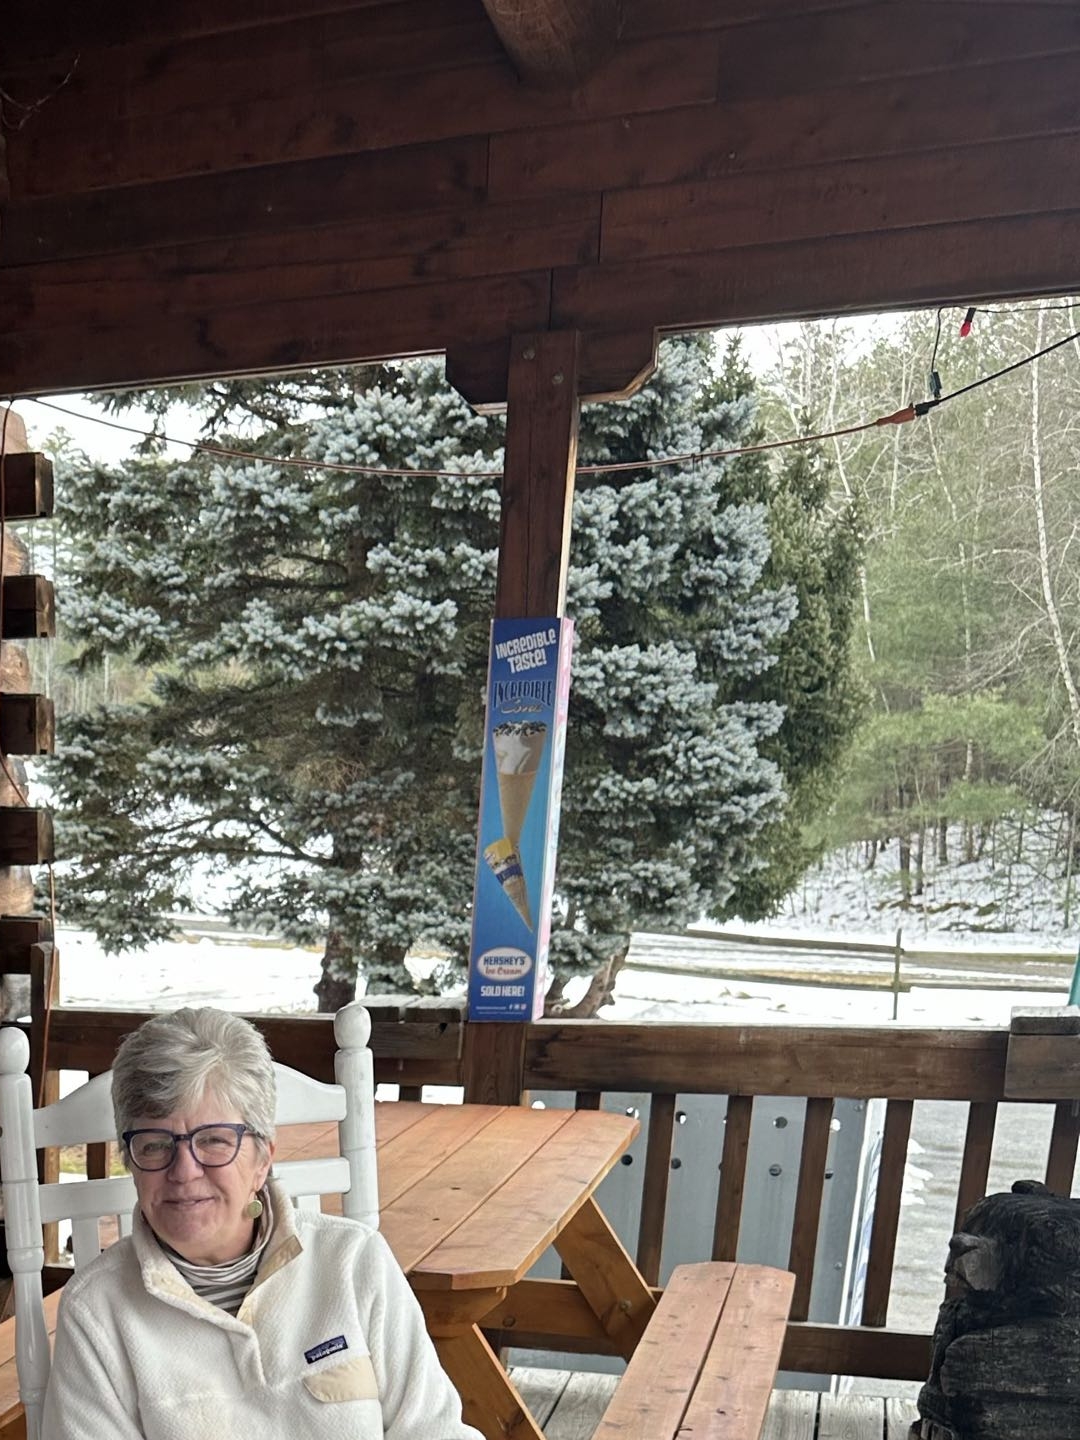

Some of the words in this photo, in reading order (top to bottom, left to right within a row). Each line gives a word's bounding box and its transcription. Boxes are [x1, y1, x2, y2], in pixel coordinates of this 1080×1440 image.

[493, 680, 553, 709] INCREDIBLE
[483, 955, 527, 966] HERSHEY'S
[480, 985, 500, 997] SOLD
[501, 985, 525, 997] HERE!
